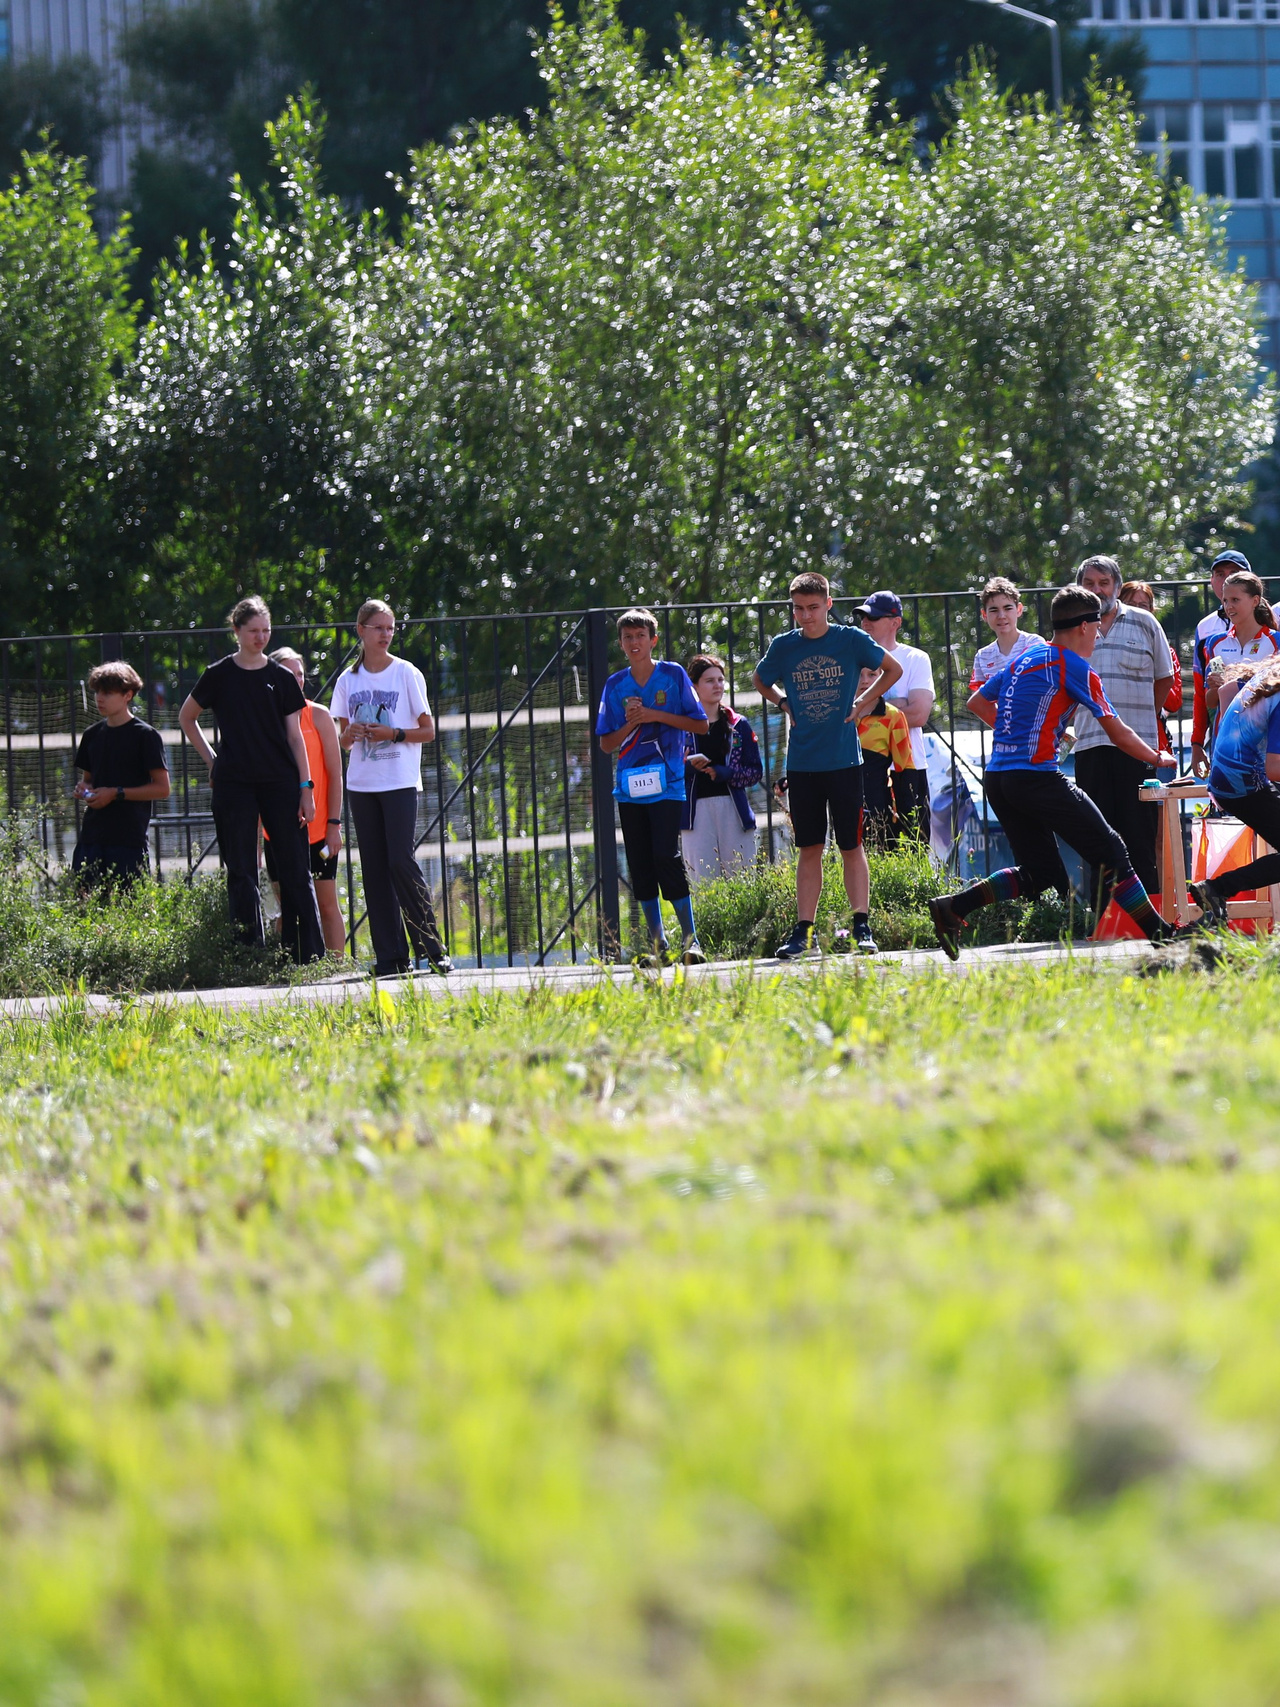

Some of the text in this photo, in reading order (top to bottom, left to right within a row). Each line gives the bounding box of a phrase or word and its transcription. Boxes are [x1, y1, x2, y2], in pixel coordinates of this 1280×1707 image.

[792, 666, 844, 682] FREE SOUL
[1002, 656, 1032, 735] ВОРОНЕЖ
[633, 778, 654, 788] 311.3
